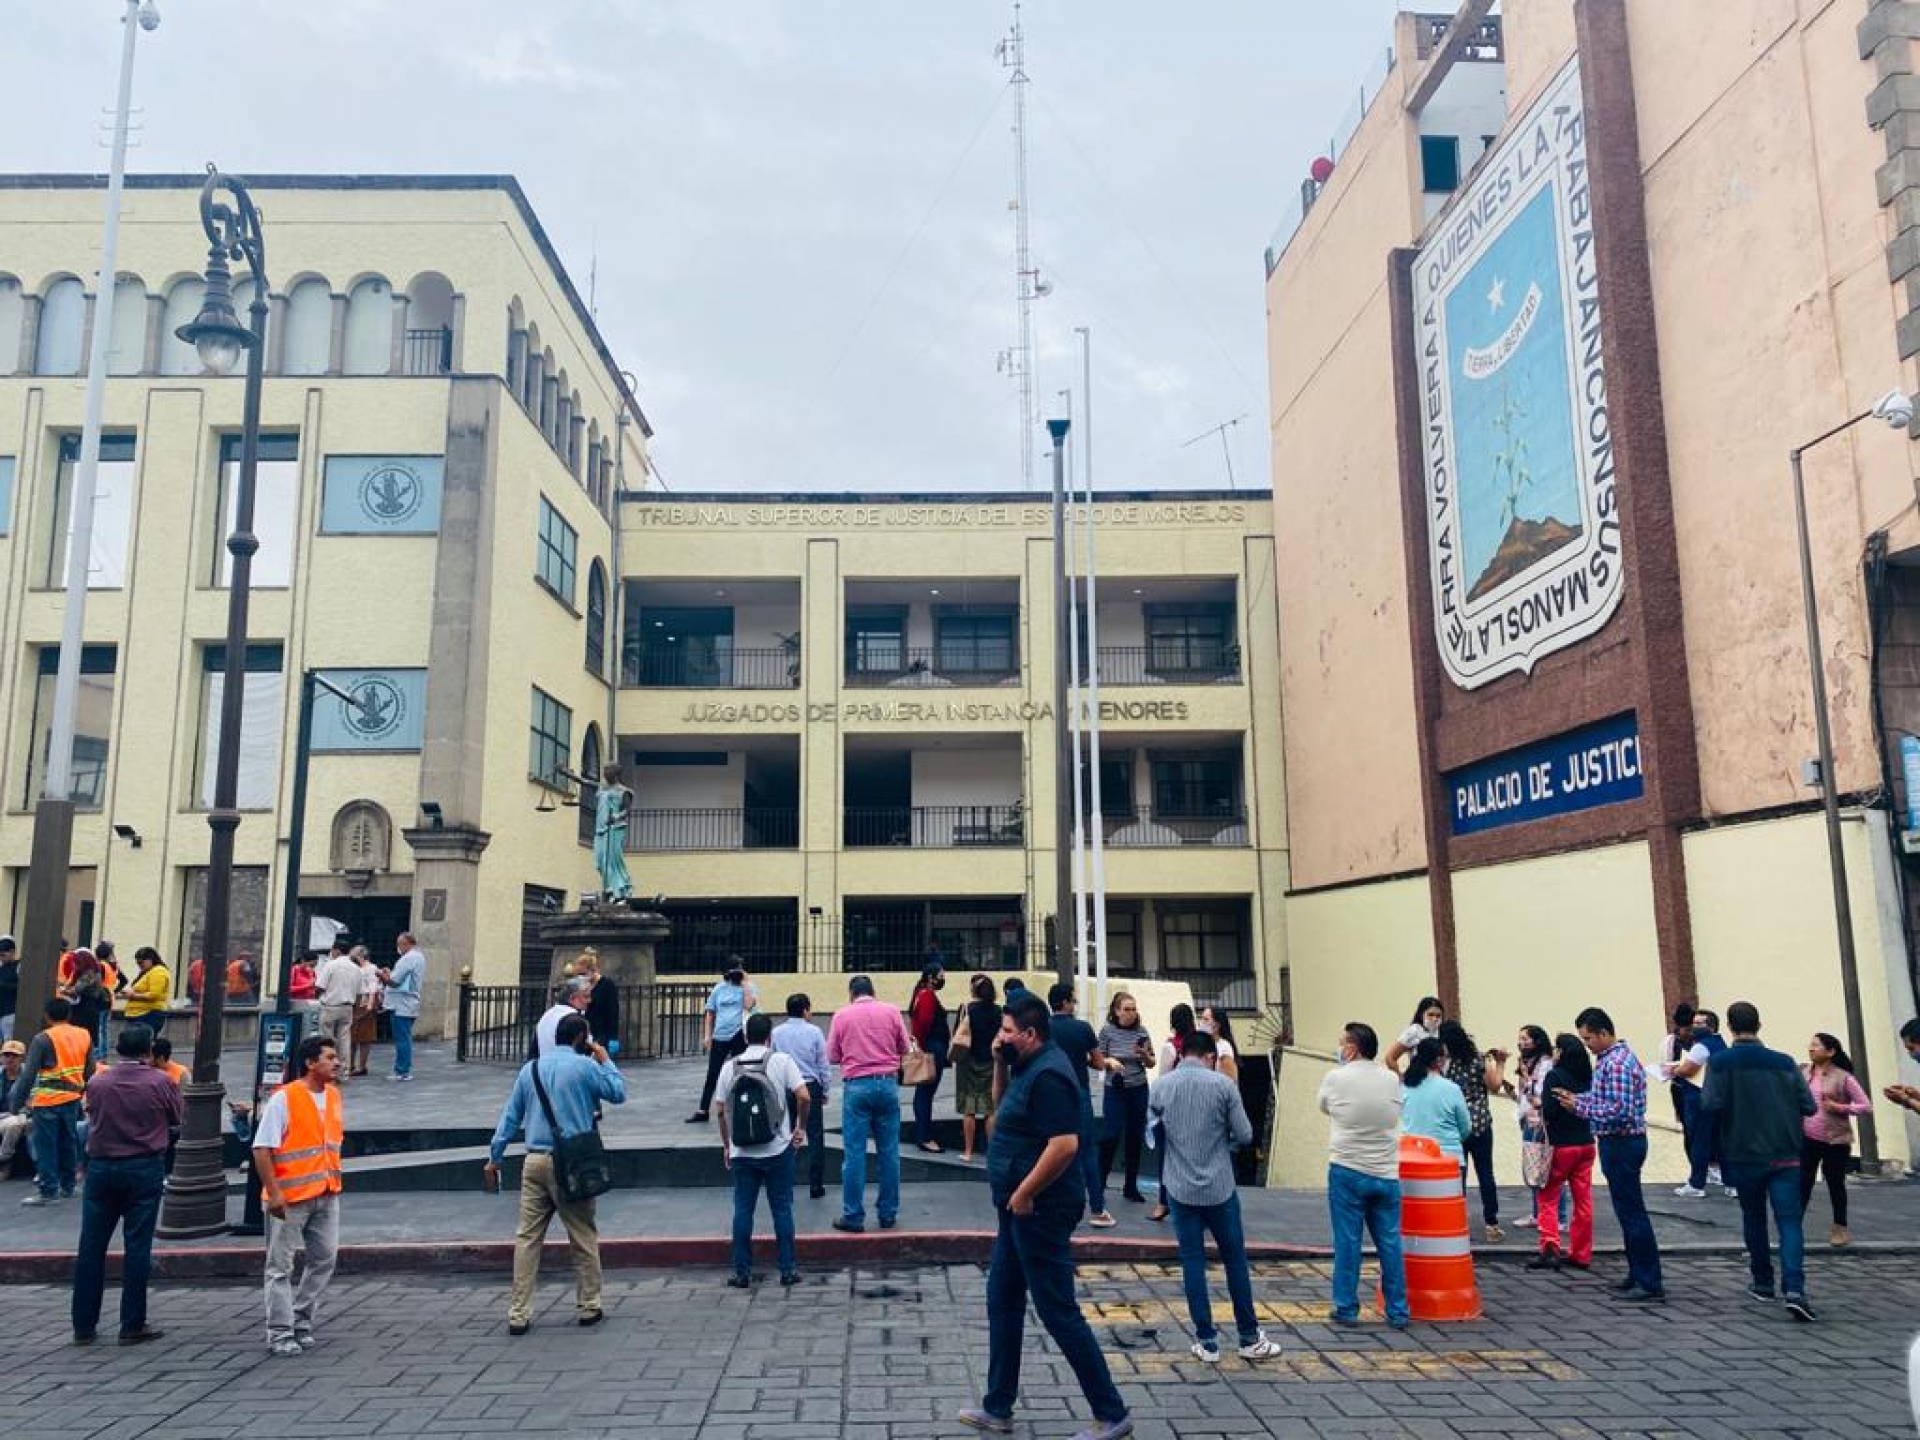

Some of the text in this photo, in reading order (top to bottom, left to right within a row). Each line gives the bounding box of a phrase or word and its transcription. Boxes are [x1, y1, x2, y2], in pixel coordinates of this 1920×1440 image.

[1517, 126, 1550, 181] LA
[1428, 167, 1513, 292] QUIENES
[1423, 299, 1437, 326] A
[1425, 331, 1448, 520] VOLVERA
[1585, 368, 1616, 486] CON
[638, 505, 1246, 526] TRIBUNAL SUPERIOR DE JUSTICIA DEL ESDO DE MORELOS
[1590, 485, 1621, 588] SUS
[1477, 612, 1505, 656] LA
[1507, 566, 1590, 642] MANOS
[681, 702, 800, 723] JUZGADOS
[806, 702, 838, 722] DE
[842, 702, 942, 721] PRIMERA
[946, 701, 1056, 721] INSTANCIA
[1456, 734, 1644, 820] PALACIO DE JUSTICI
[428, 895, 442, 915] 7
